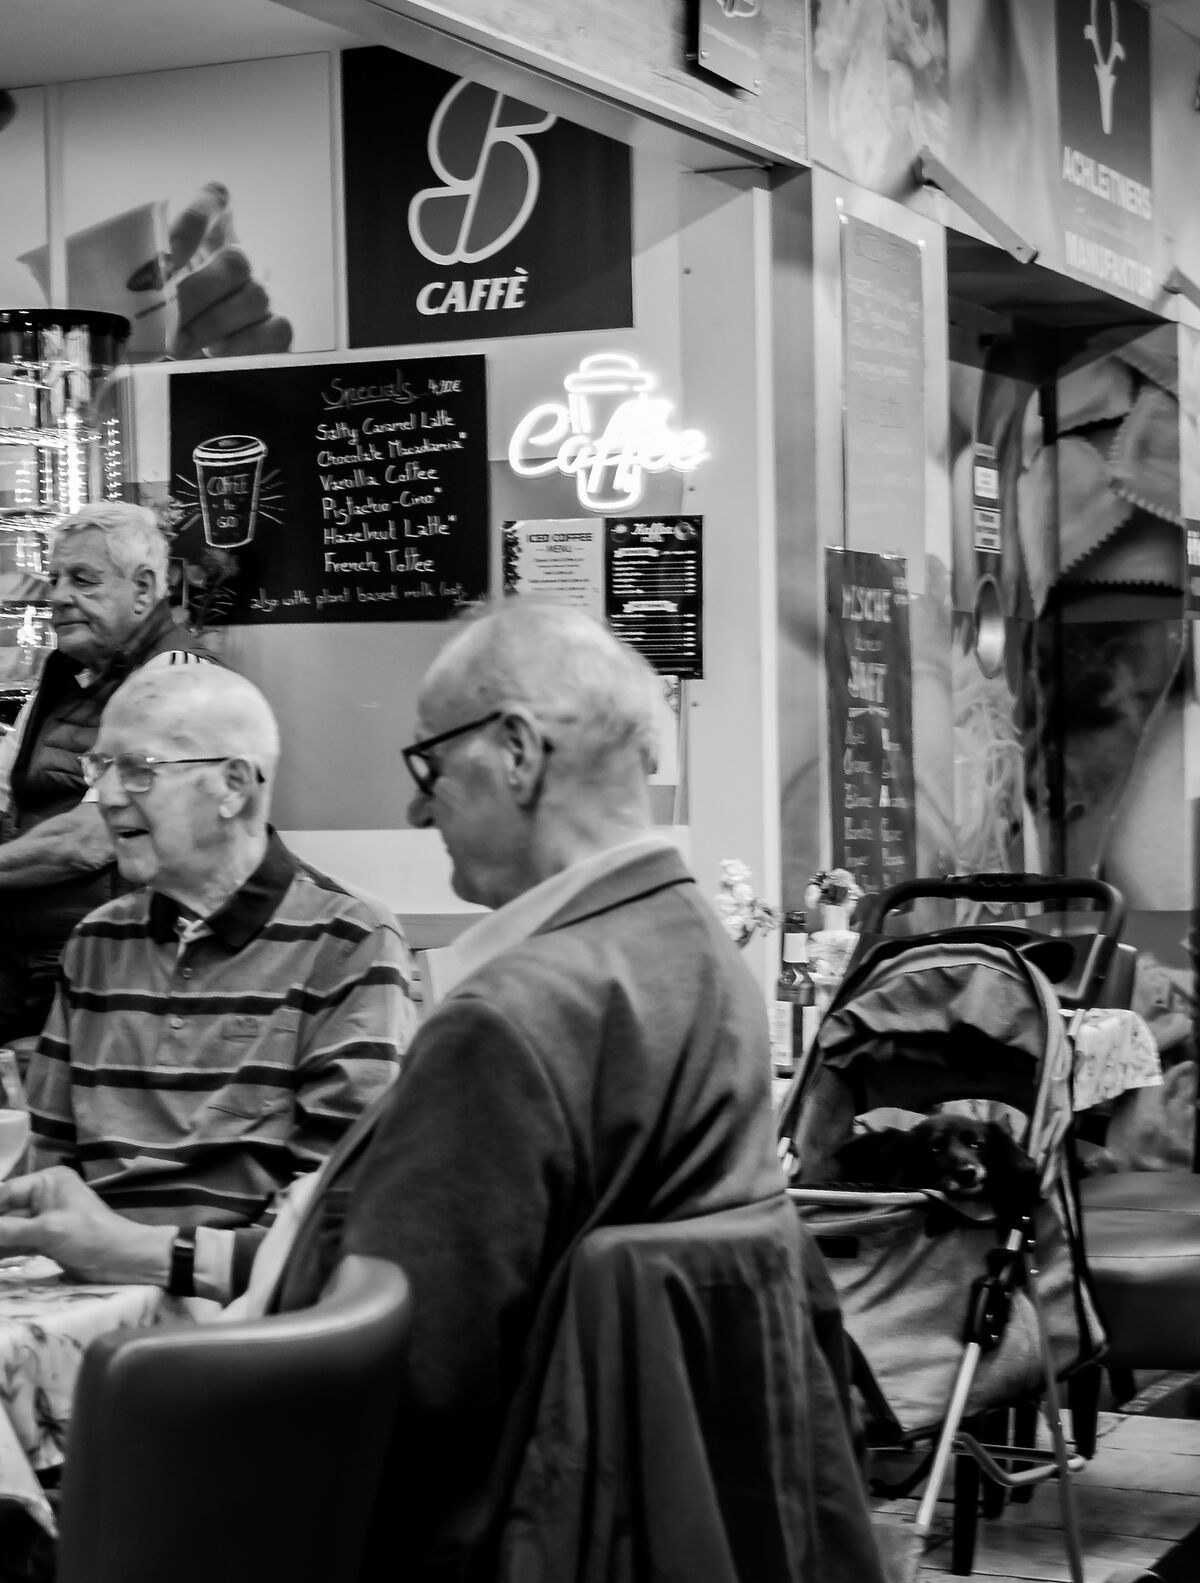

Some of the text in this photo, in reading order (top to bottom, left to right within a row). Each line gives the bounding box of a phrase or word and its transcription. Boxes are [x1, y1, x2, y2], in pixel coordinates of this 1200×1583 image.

[416, 266, 529, 315] CAFFÈ
[321, 369, 419, 409] Specials
[315, 410, 456, 445] Salty Caramel Latte
[317, 443, 385, 467] Chocolate
[508, 399, 710, 497] Coffee
[319, 461, 440, 491] Vanilla Coffee
[324, 520, 398, 545] Hazelnut
[526, 531, 593, 543] ICED COFFEE
[324, 551, 381, 572] French
[546, 544, 572, 553] MENU
[282, 590, 311, 605] with
[316, 588, 350, 609] plant
[357, 585, 400, 601] based
[403, 581, 436, 598] milk
